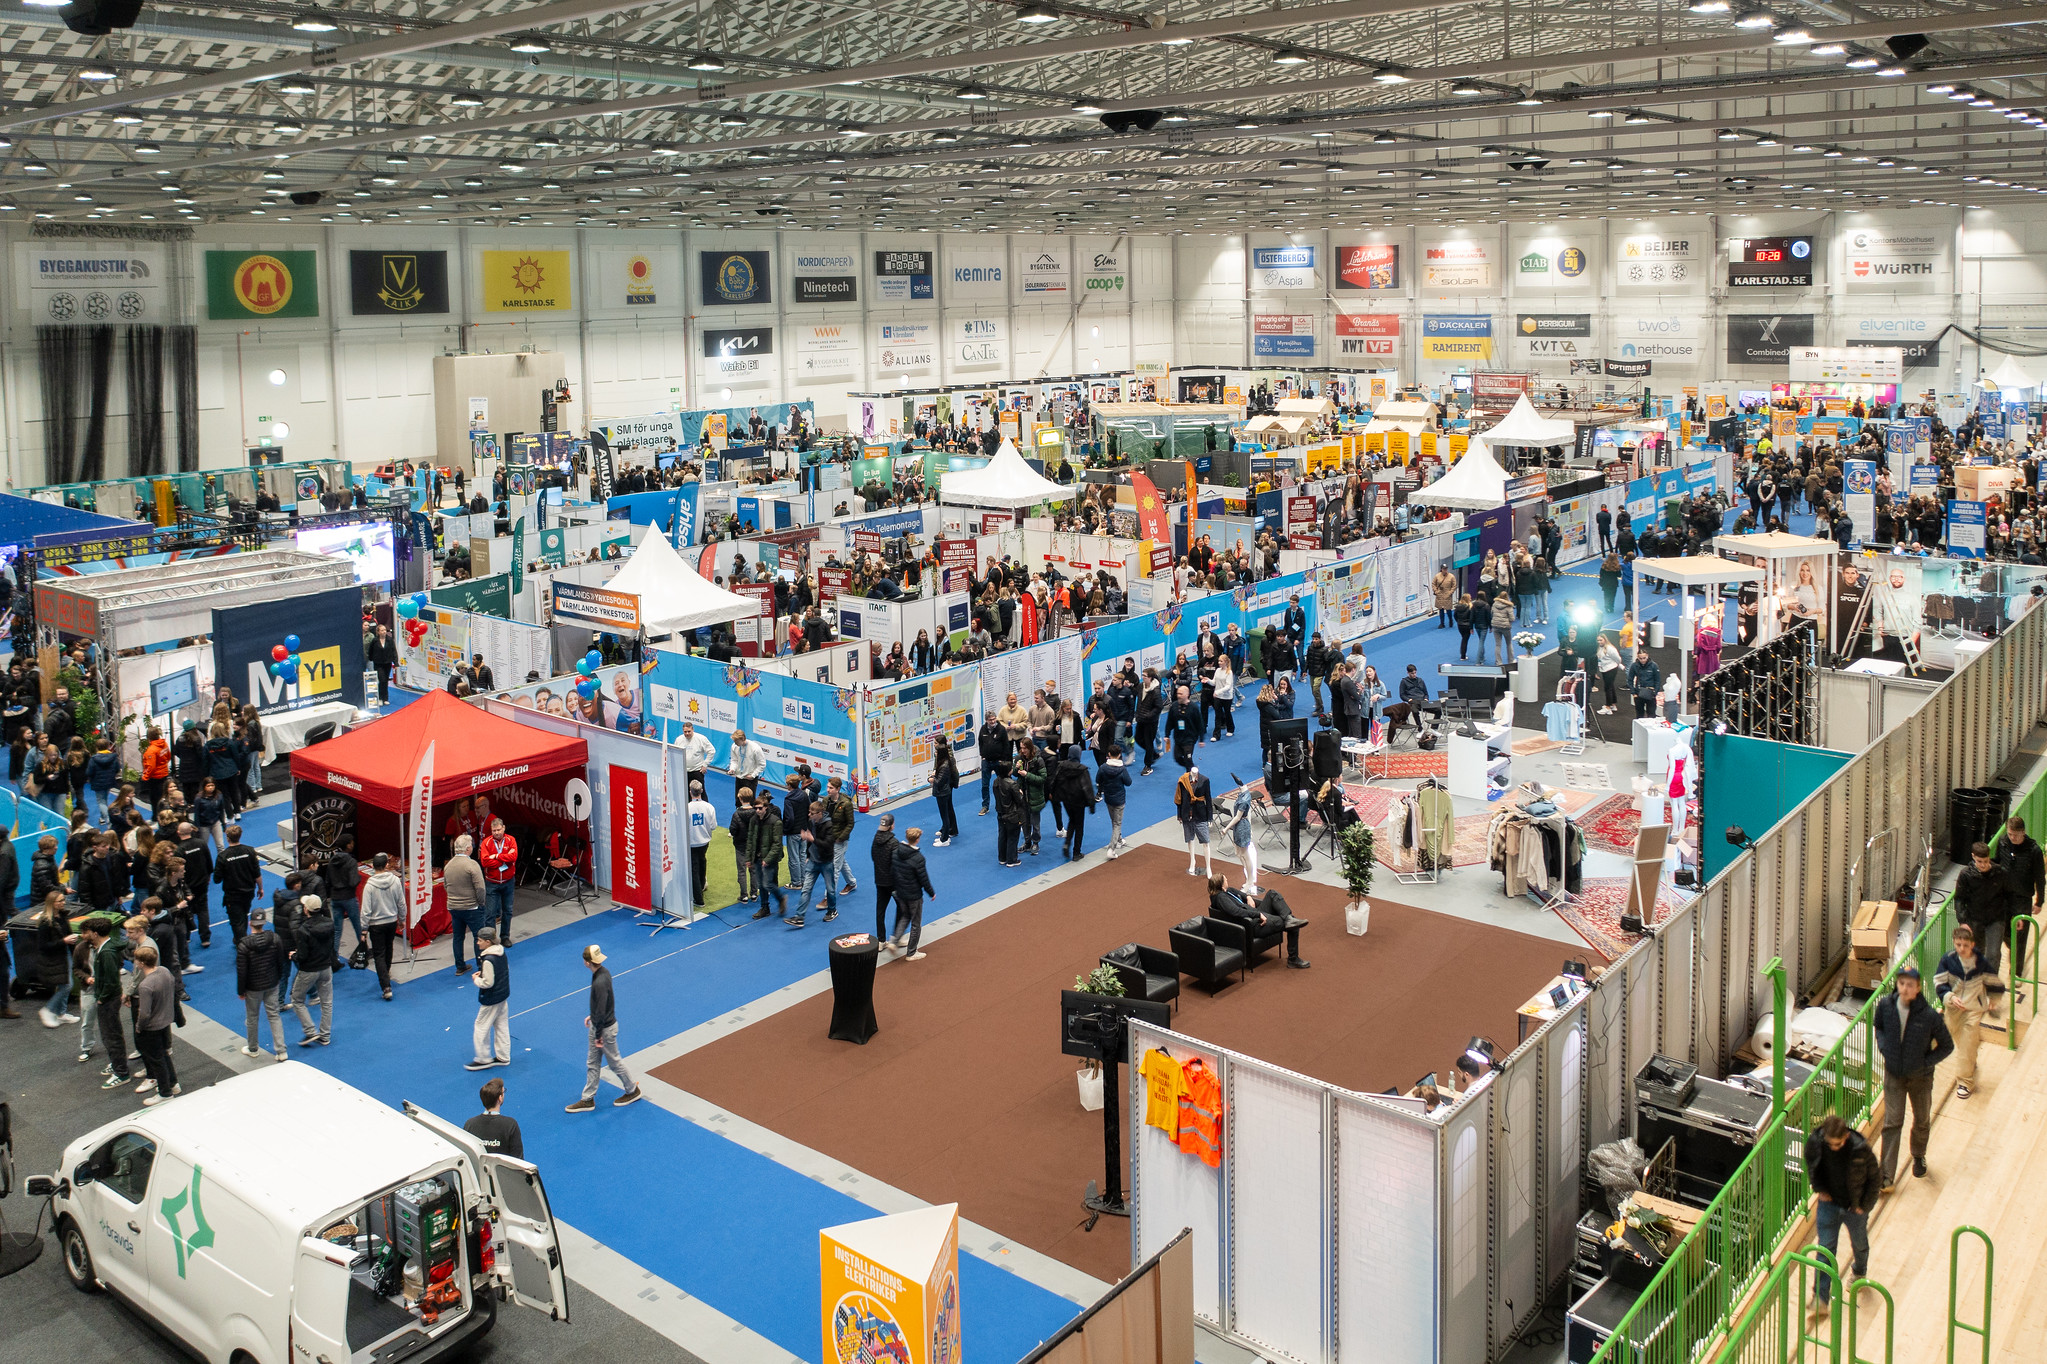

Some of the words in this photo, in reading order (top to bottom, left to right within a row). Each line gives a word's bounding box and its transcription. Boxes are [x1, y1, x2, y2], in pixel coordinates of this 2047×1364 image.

[1644, 240, 1688, 251] BEIJER
[798, 256, 848, 266] NORDICPAPER
[1094, 254, 1116, 268] Elms
[1260, 252, 1306, 264] ÖSTERBERGS
[1756, 251, 1781, 261] 10:28
[40, 259, 128, 274] BYGGAKUSTIK
[1522, 258, 1548, 268] CIAB
[1874, 263, 1932, 274] WÜRTH
[388, 260, 410, 290] V
[954, 267, 1002, 282] kemira
[1734, 275, 1806, 285] KARLSTAD.SE
[803, 280, 849, 293] Ninetech
[1086, 278, 1114, 292] coop
[1278, 276, 1302, 286] Aspia
[390, 298, 412, 309] AIK
[502, 298, 556, 308] KARLSTAD.SE
[632, 296, 650, 304] KSK
[974, 320, 996, 334] TM:s
[1439, 321, 1487, 329] DÄCKALEN
[1538, 320, 1575, 328] DERBIGUM
[1638, 318, 1670, 332] two
[1859, 318, 1926, 332] elvenite
[720, 336, 758, 350] KIA
[1342, 340, 1364, 353] NWT
[1368, 341, 1390, 352] VF
[1432, 343, 1482, 353] RAMIRENT
[1530, 340, 1558, 351] KVT
[1638, 343, 1692, 355] nethouse
[1746, 348, 1790, 356] CombinedX
[720, 361, 746, 372] Wafab
[748, 360, 759, 370] Bil
[896, 354, 931, 366] ALLIANS
[1609, 363, 1647, 372] OPTIMERA
[616, 424, 632, 435] SM
[634, 422, 648, 433] för
[650, 422, 674, 434] unga
[1954, 502, 1974, 511] FRISÖR
[876, 519, 920, 534] Telemontage
[943, 548, 975, 556] BIBLIOTEKET
[482, 584, 506, 596] VÄRMLAND
[735, 586, 770, 594] VÄGLEDNINGS-
[556, 586, 591, 600] VÄRMLANDS
[594, 593, 634, 608] YRKESFOKUS
[1840, 595, 1860, 603] SPORT
[561, 600, 598, 614] VÄRMLANDS
[599, 608, 635, 622] YRKESTORG
[868, 602, 888, 613] ITAKT
[304, 660, 334, 682] Yh
[288, 701, 298, 709] för
[298, 692, 343, 708] yrkeshögskolan
[785, 702, 796, 714] afa
[718, 710, 733, 719] Region
[719, 714, 736, 724] Värmland
[814, 761, 822, 769] 3M
[327, 771, 362, 792] Elektrikerna
[470, 764, 529, 789] Elektrikerna
[306, 798, 346, 816] UNION
[416, 776, 432, 906] Elektrikerna
[623, 785, 640, 890] Elektrikerna
[106, 1220, 134, 1255] bravida
[834, 1245, 907, 1293] INSTALLATIONS-
[844, 1264, 897, 1304] ELEKTRIKER
